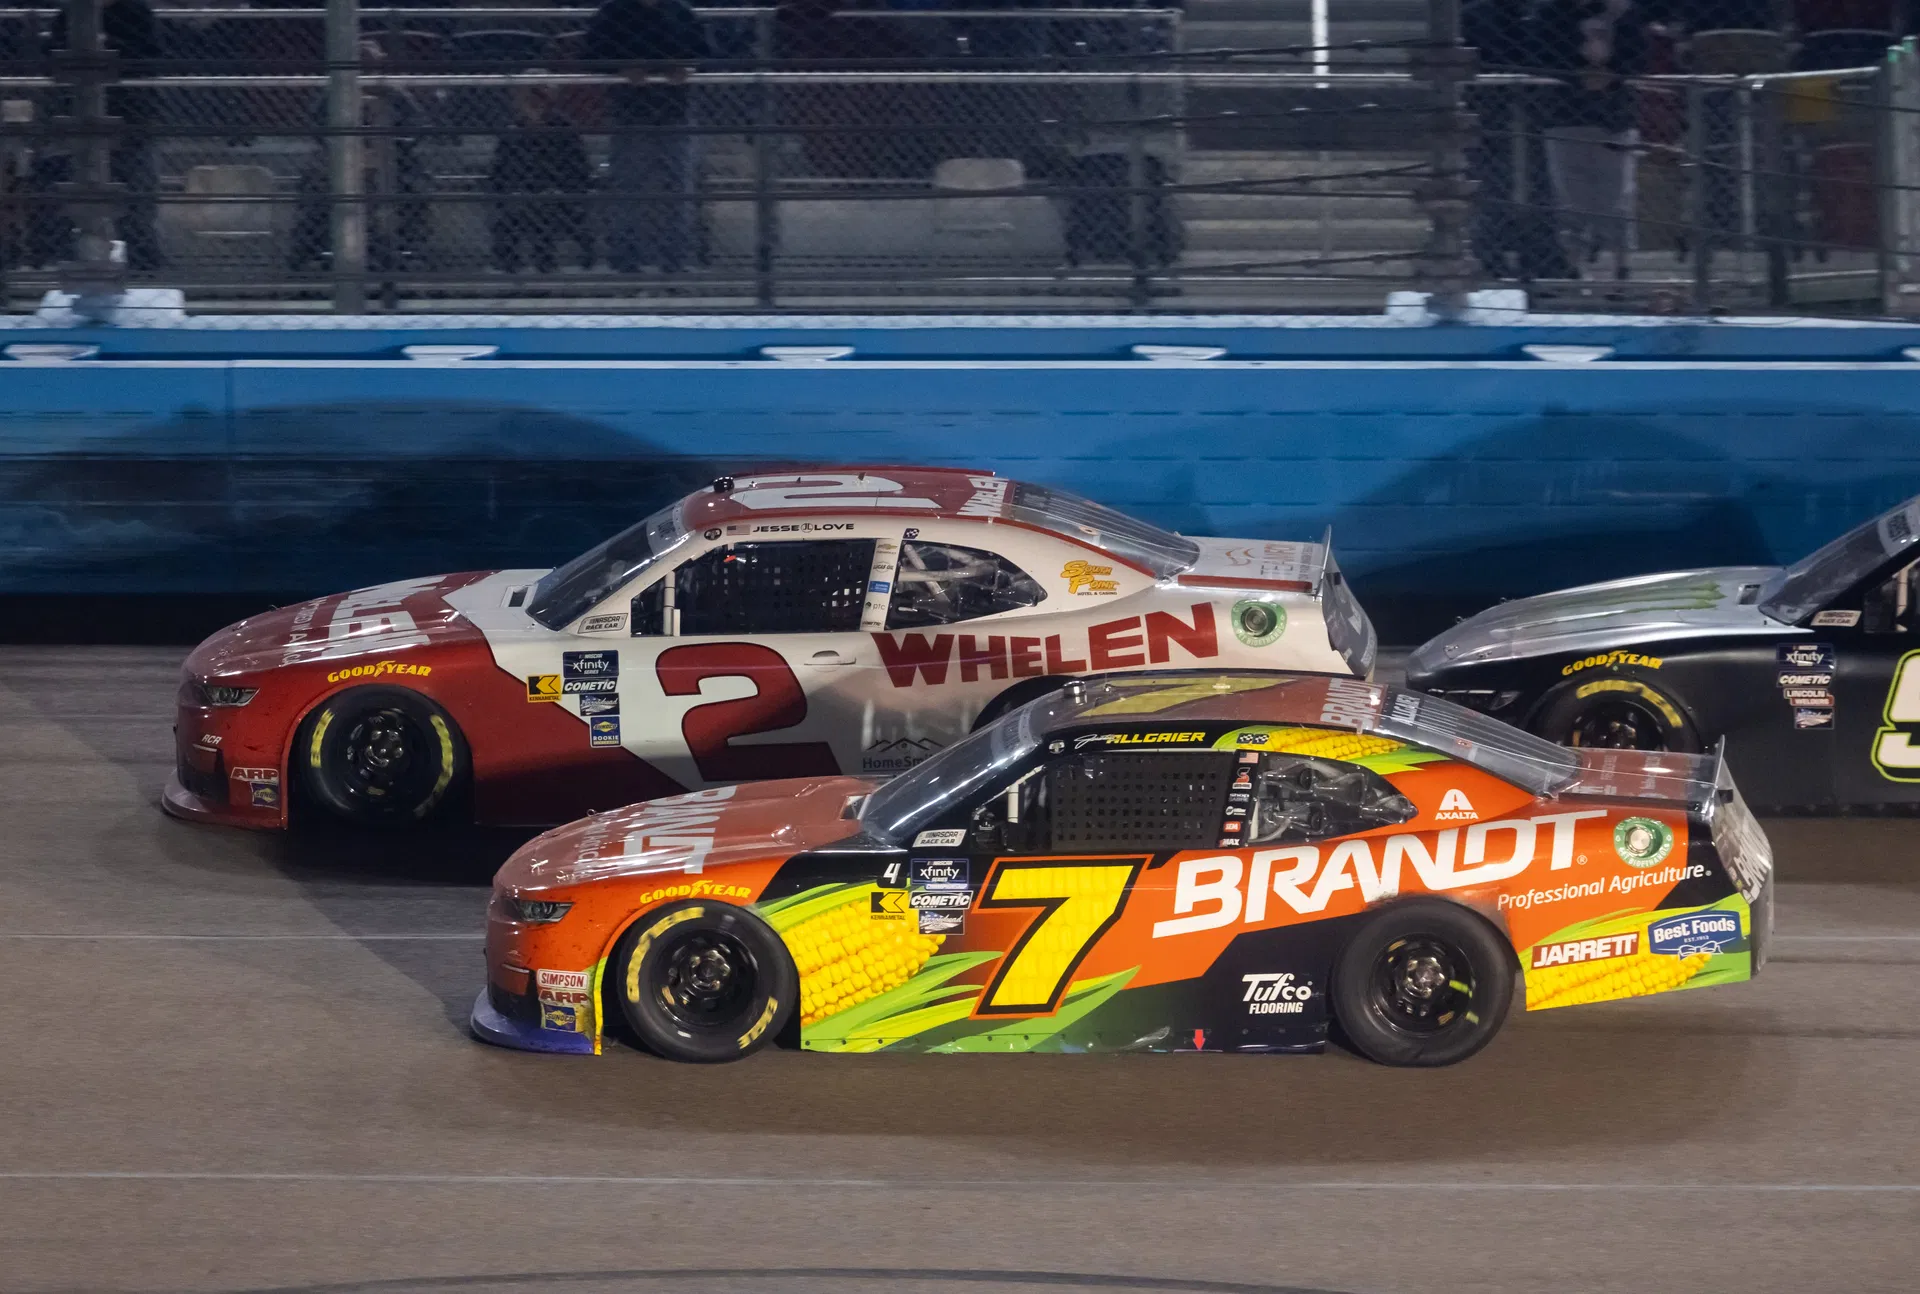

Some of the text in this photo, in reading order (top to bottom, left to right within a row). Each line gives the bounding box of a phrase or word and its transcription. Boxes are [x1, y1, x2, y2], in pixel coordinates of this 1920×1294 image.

[753, 524, 800, 532] JESSE
[814, 523, 854, 531] LOVE
[593, 616, 620, 624] NASCAR
[871, 602, 1218, 688] WHELEN
[1562, 650, 1663, 676] GOODYEAR
[1786, 651, 1824, 664] xfinity
[327, 660, 431, 683] GOODYEAR
[573, 659, 609, 672] xfinity
[564, 679, 616, 692] COMETIC
[1780, 674, 1831, 685] COMETIC
[1786, 690, 1826, 698] LINCOLN
[655, 642, 843, 783] 2
[201, 734, 222, 744] RCR
[1106, 732, 1206, 744] ALLGAIER
[862, 753, 932, 769] HomeSm
[231, 768, 279, 781] ARP
[1435, 811, 1479, 820] AXALTA
[883, 863, 901, 884] 4
[920, 866, 960, 879] xfinity
[1152, 810, 1608, 939] BRANDT
[640, 880, 751, 904] GOODYEAR
[1497, 863, 1704, 911] Professional Agriculture
[911, 893, 970, 906] COMETIC
[980, 856, 1146, 1015] 7
[1653, 917, 1736, 944] Best Foods
[1533, 933, 1637, 967] JARRETT
[541, 972, 585, 987] SIMPSON
[1242, 972, 1312, 1002] Tufco
[539, 989, 588, 1004] ARP
[1249, 1002, 1304, 1014] FLOORING
[545, 1013, 576, 1023] SUNOCO
